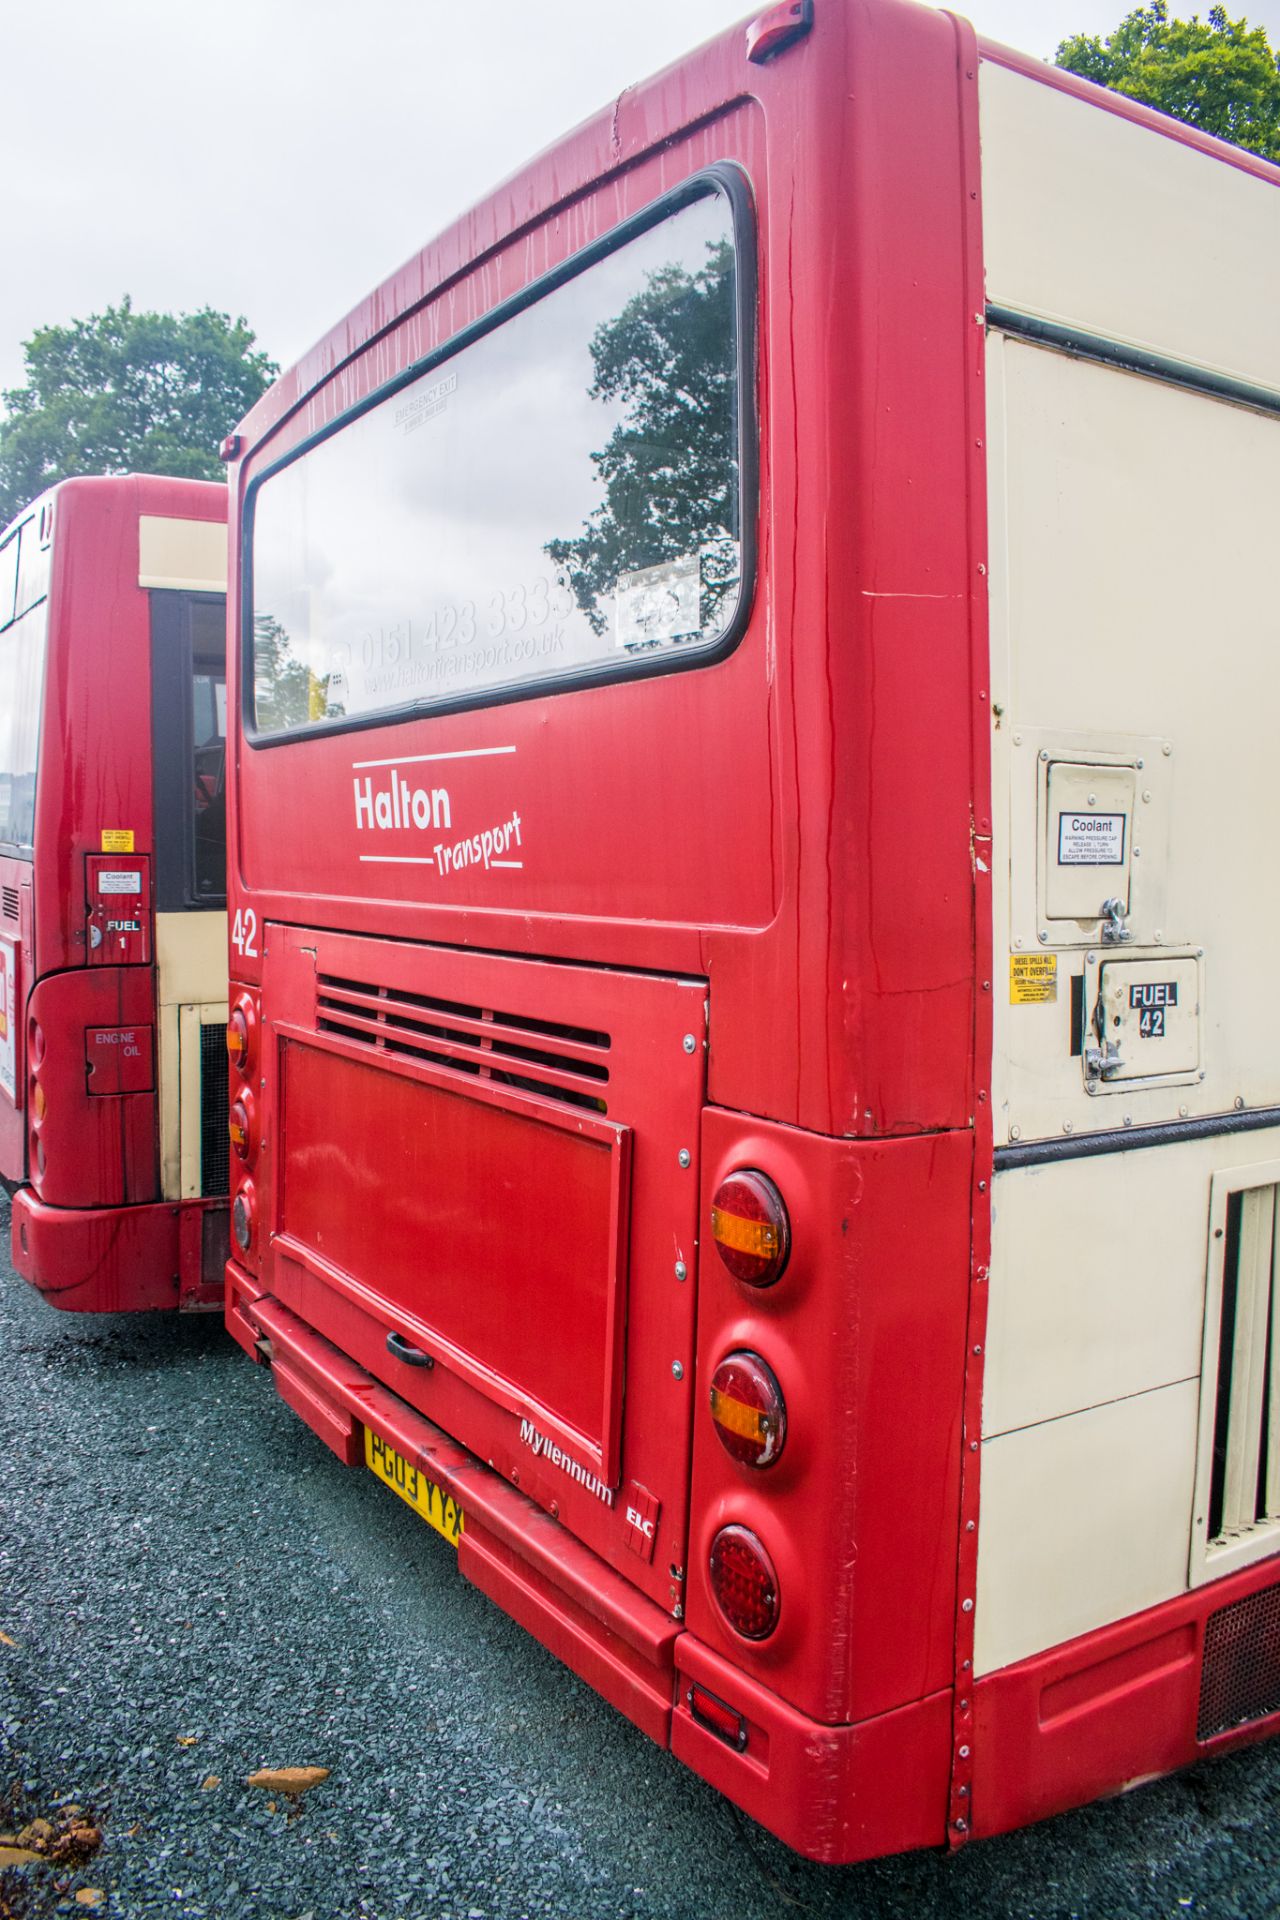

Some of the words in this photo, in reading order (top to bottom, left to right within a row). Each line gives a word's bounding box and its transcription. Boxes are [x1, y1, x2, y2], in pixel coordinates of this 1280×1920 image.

[439, 374, 456, 396] EXIT
[361, 619, 412, 672] 0151
[423, 600, 477, 652] 423
[487, 569, 574, 637] 3333
[363, 624, 566, 695] www.haltontransport.co.uk
[353, 769, 452, 830] Halton
[1071, 818, 1113, 832] Coolant
[433, 810, 522, 876] Transport
[107, 921, 140, 931] FUEL
[231, 907, 258, 958] 42
[119, 936, 126, 949] 1
[1013, 967, 1028, 977] DON'T
[1131, 985, 1175, 1007] FUEL
[1140, 1010, 1163, 1035] 42
[123, 1046, 142, 1057] OIL
[519, 1418, 613, 1507] Myllennium
[371, 1432, 419, 1502] PG03
[425, 1475, 462, 1537] YYX
[626, 1505, 654, 1539] ELC
